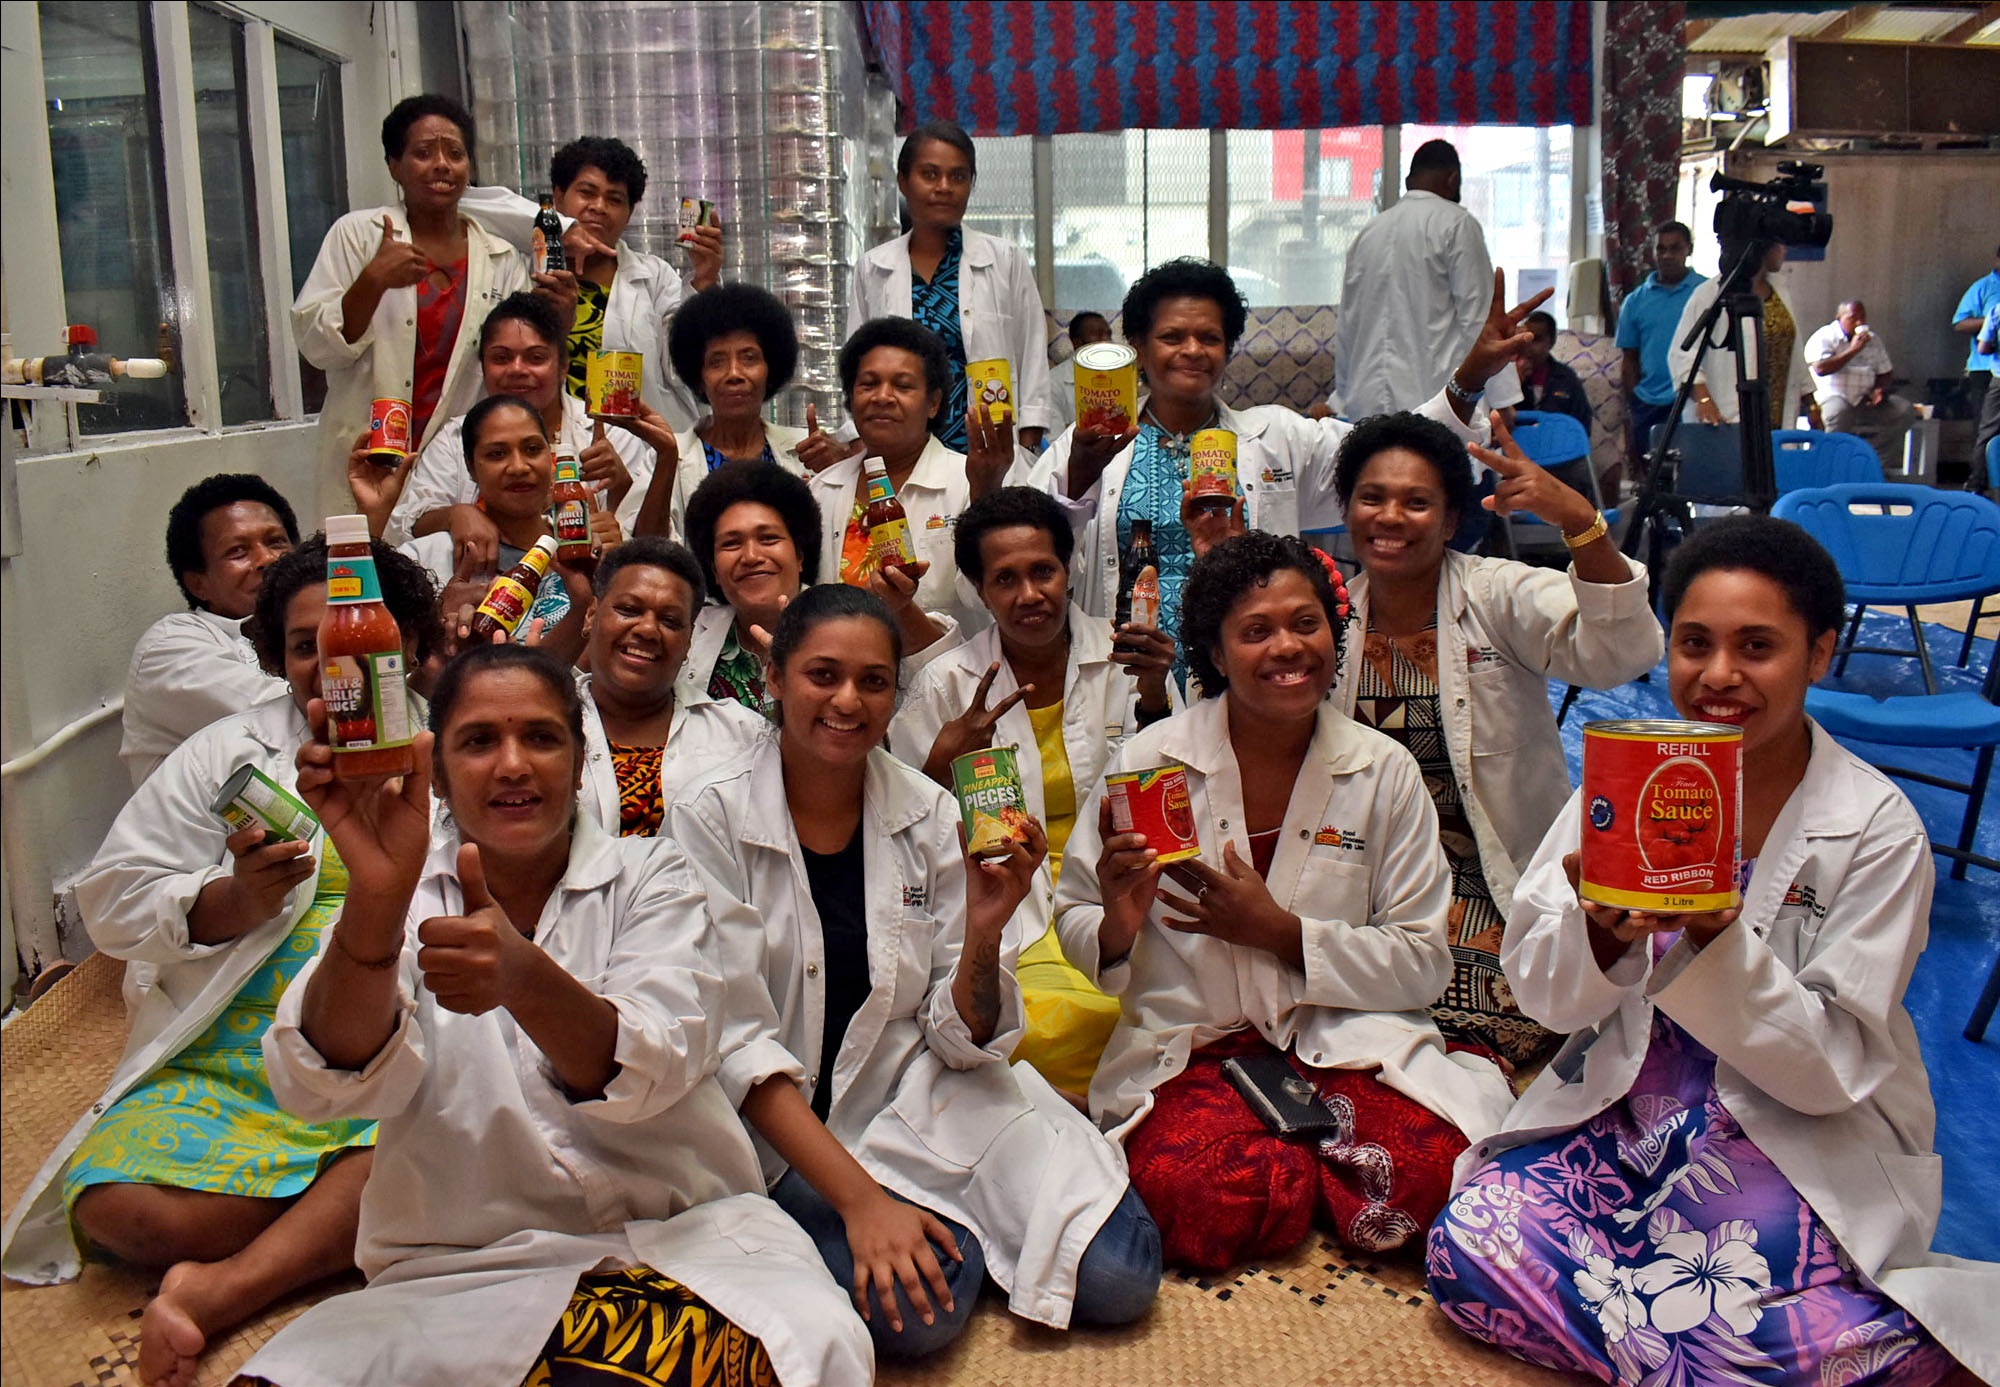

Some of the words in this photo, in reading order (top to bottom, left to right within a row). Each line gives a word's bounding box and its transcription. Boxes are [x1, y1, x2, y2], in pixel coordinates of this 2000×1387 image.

[604, 370, 639, 379] TOMATO
[609, 379, 636, 388] SAUCE
[1080, 385, 1121, 397] TOMATO
[1083, 396, 1115, 405] SAUCE
[1192, 450, 1231, 460] TOMATO
[1194, 459, 1226, 469] SAUCE
[560, 518, 584, 526] SAUCE
[322, 679, 349, 689] HILLI
[351, 678, 362, 688] &
[326, 700, 358, 712] SAUCE
[1657, 742, 1711, 756] REFILL
[963, 776, 1014, 794] PINEAPPLE
[1671, 777, 1698, 787] Finest
[1650, 784, 1714, 800] Tomato
[964, 786, 1016, 811] PIECES
[1651, 800, 1714, 819] Sauce
[1644, 875, 1668, 884] RED
[1671, 868, 1714, 881] RIBBON
[1663, 897, 1670, 906] 3
[1672, 897, 1694, 906] Litre
